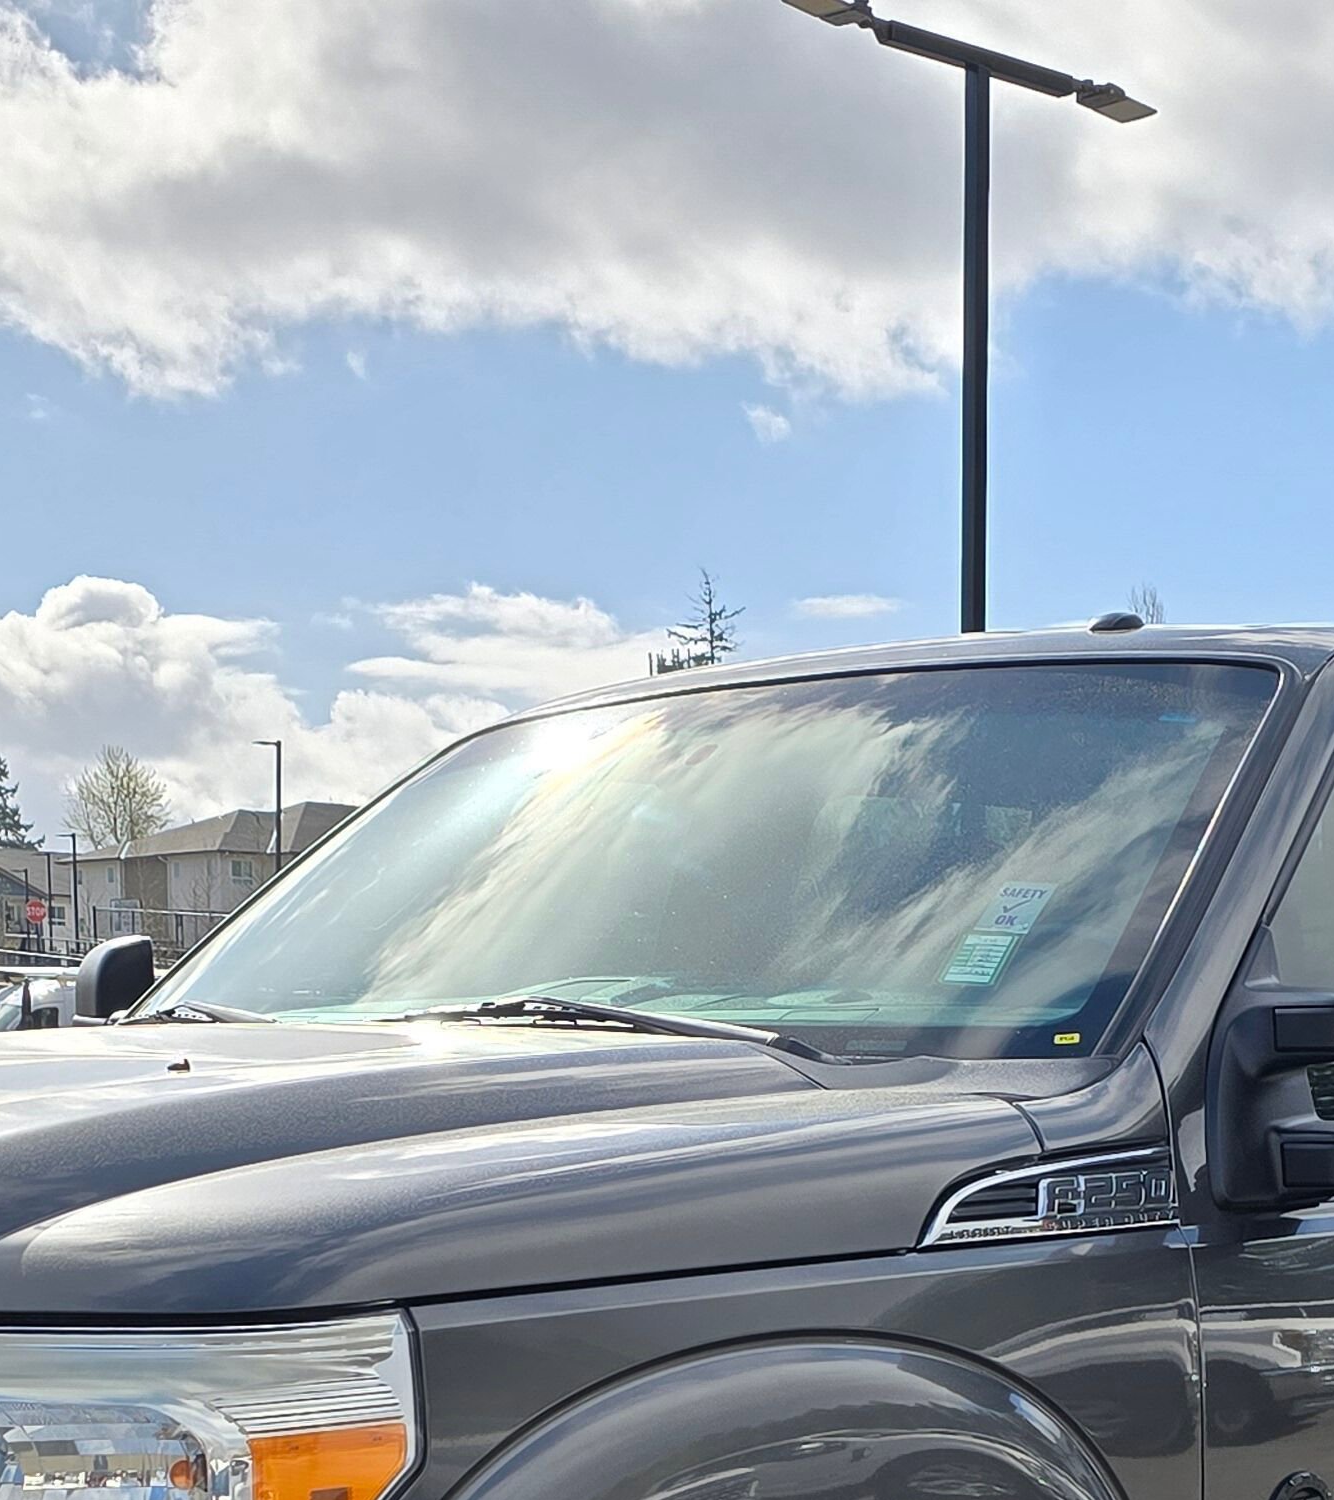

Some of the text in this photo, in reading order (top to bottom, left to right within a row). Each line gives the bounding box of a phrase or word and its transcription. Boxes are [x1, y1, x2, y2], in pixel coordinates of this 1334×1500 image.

[1000, 887, 1048, 899] SAFETY
[27, 906, 45, 916] STOP
[994, 914, 1018, 926] OK
